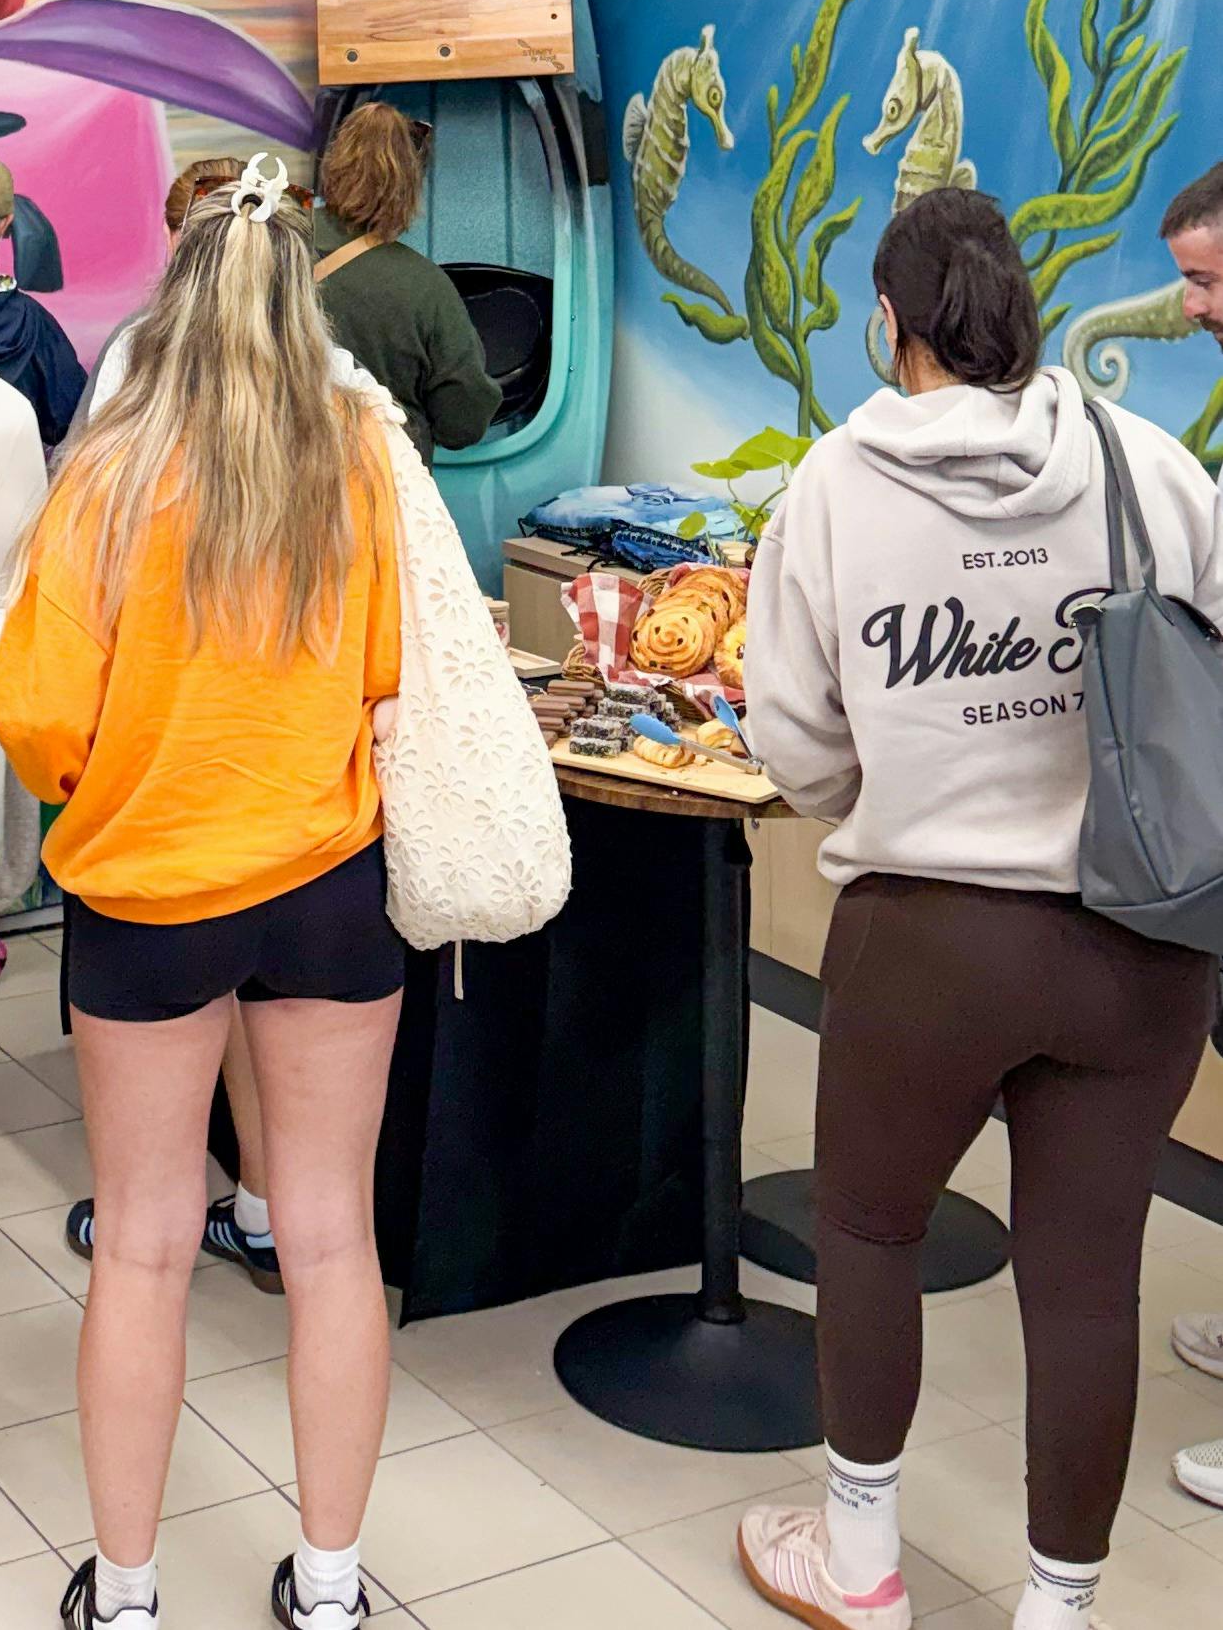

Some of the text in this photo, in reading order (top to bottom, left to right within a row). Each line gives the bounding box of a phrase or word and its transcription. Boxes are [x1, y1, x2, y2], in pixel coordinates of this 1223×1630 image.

[961, 547, 1049, 570] EST.2013
[861, 596, 1042, 689] White
[962, 693, 1067, 726] SEASON
